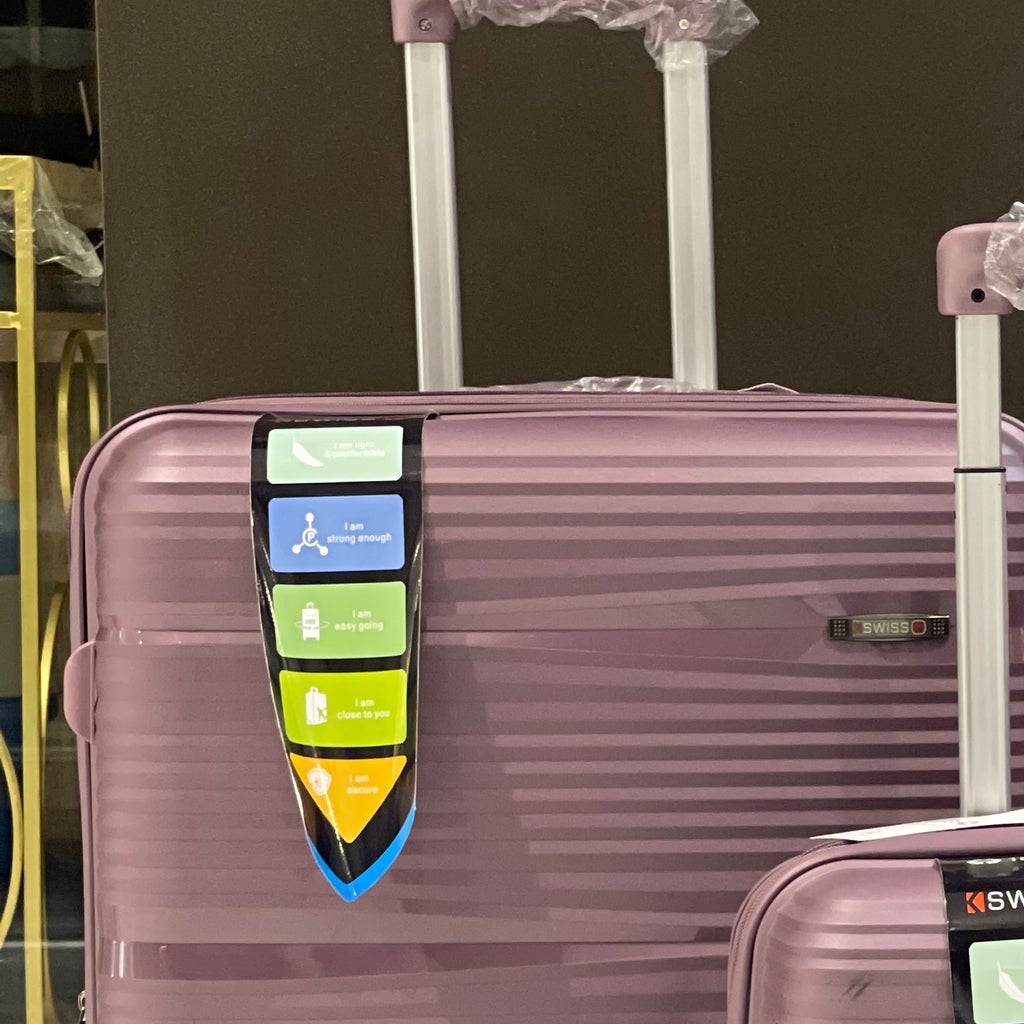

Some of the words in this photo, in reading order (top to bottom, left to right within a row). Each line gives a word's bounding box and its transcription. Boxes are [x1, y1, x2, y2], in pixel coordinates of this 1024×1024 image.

[326, 533, 356, 544] strong
[357, 533, 392, 544] enough
[357, 610, 372, 618] am
[334, 622, 356, 632] easy
[358, 621, 384, 632] going
[360, 699, 374, 707] am
[336, 710, 362, 720] close
[363, 710, 372, 718] to
[374, 710, 390, 720] you
[346, 786, 379, 794] secure
